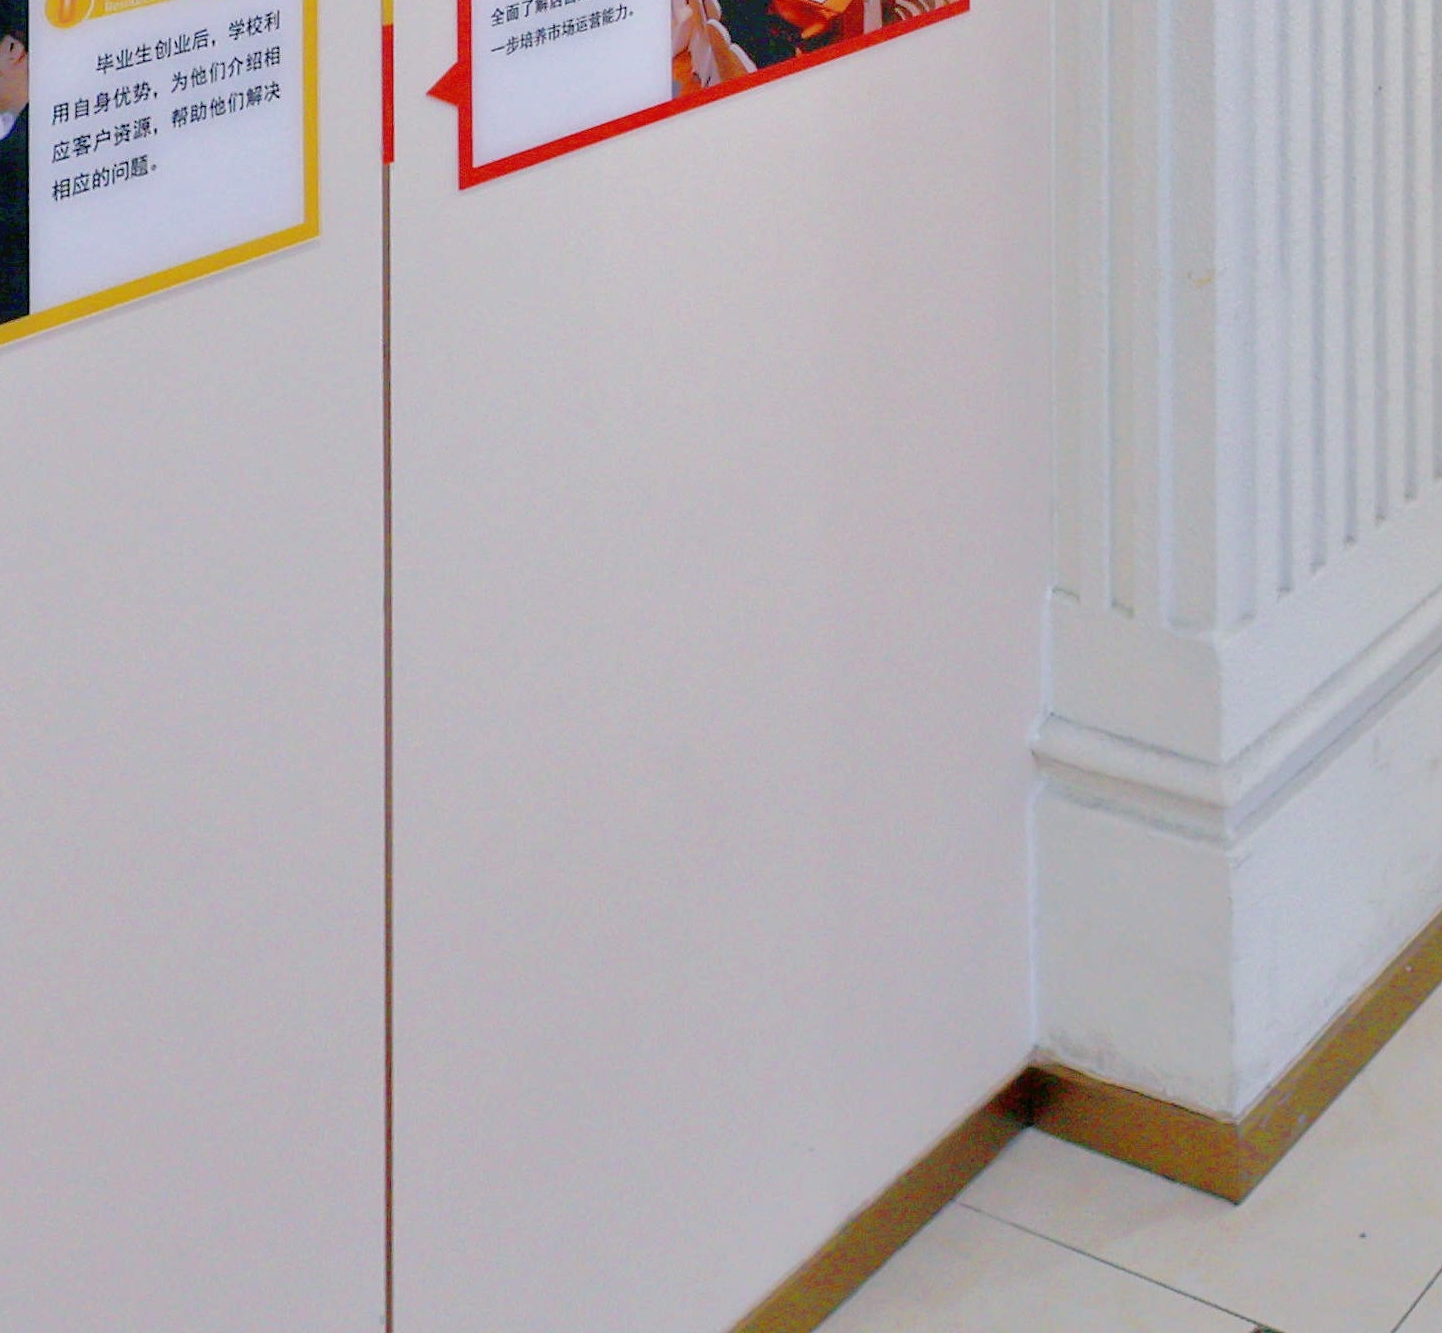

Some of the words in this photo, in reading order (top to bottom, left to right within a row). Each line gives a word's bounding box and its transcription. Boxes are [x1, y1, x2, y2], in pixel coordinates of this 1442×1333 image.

[95, 10, 280, 74] 毕业生创业后，学校利
[491, 4, 634, 56] 一步培养市场运营能力。
[52, 46, 280, 126] 用自身优势，为他们介绍相
[52, 82, 281, 164] 应客户资源，帮助他们解决
[52, 155, 157, 201] 相应的问题。
